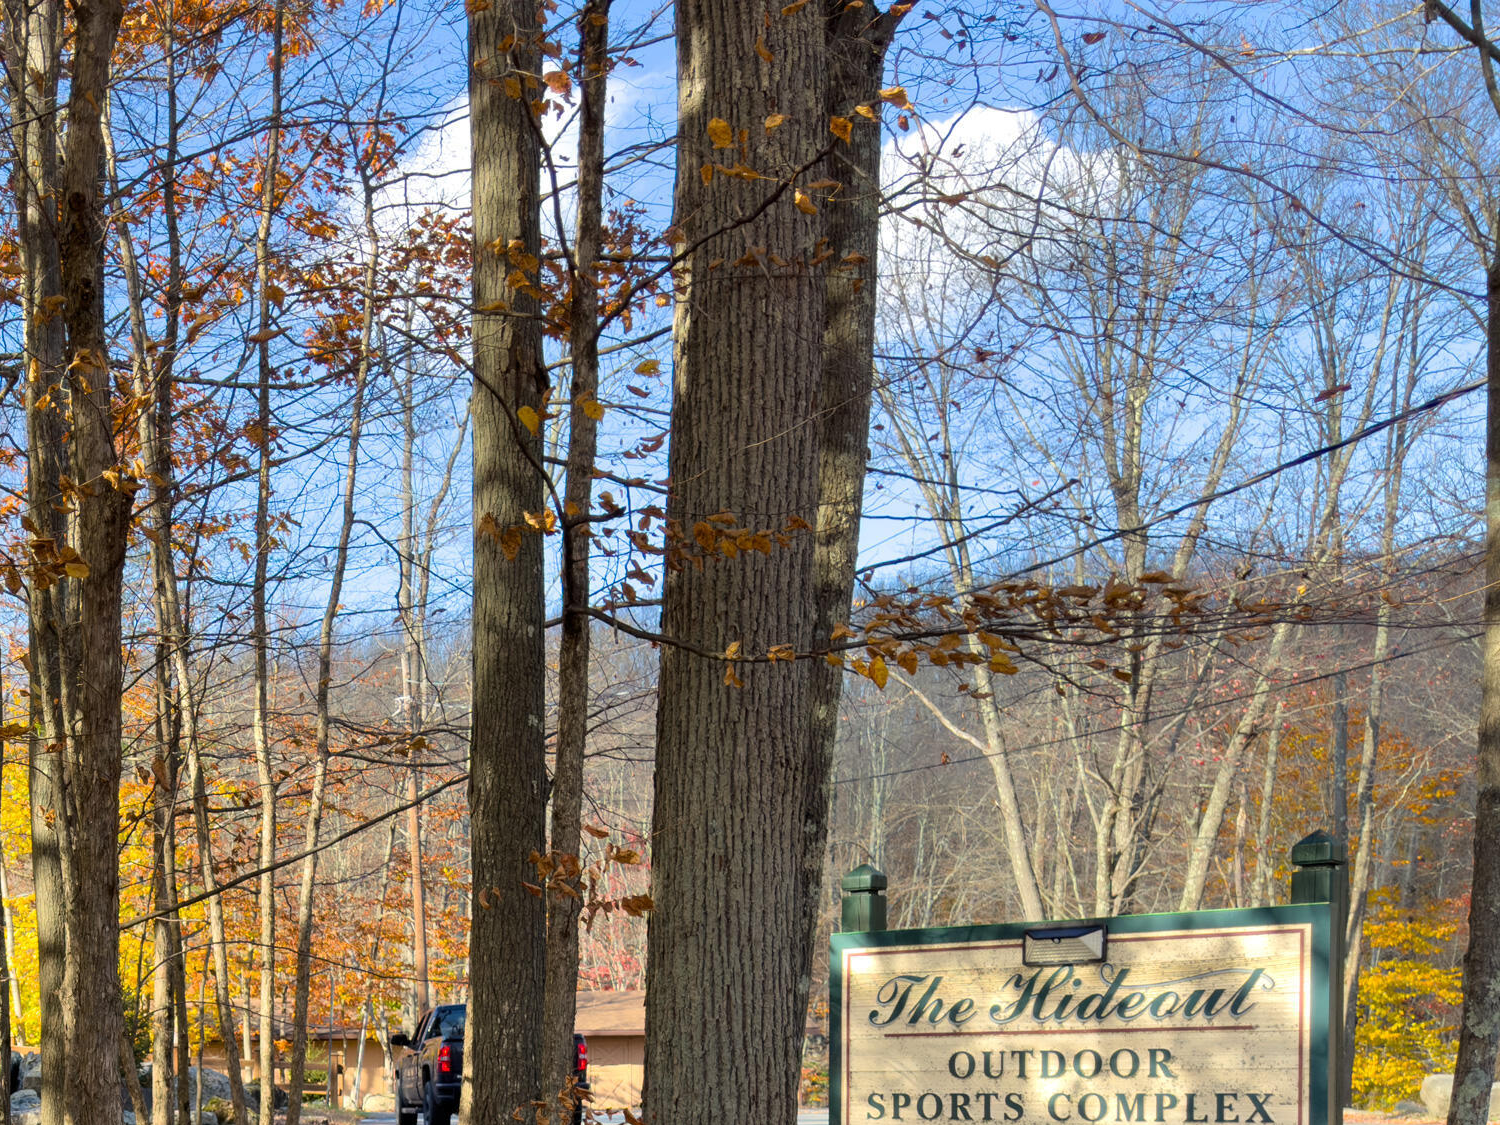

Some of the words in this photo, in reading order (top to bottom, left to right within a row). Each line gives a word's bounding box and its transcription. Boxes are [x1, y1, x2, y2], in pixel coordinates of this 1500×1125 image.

[868, 974, 978, 1029] The
[989, 963, 1275, 1024] Hideout
[947, 1048, 1178, 1080] OUTDOOR
[866, 1091, 1025, 1121] SPORTS
[1047, 1092, 1276, 1124] COMPLEX
